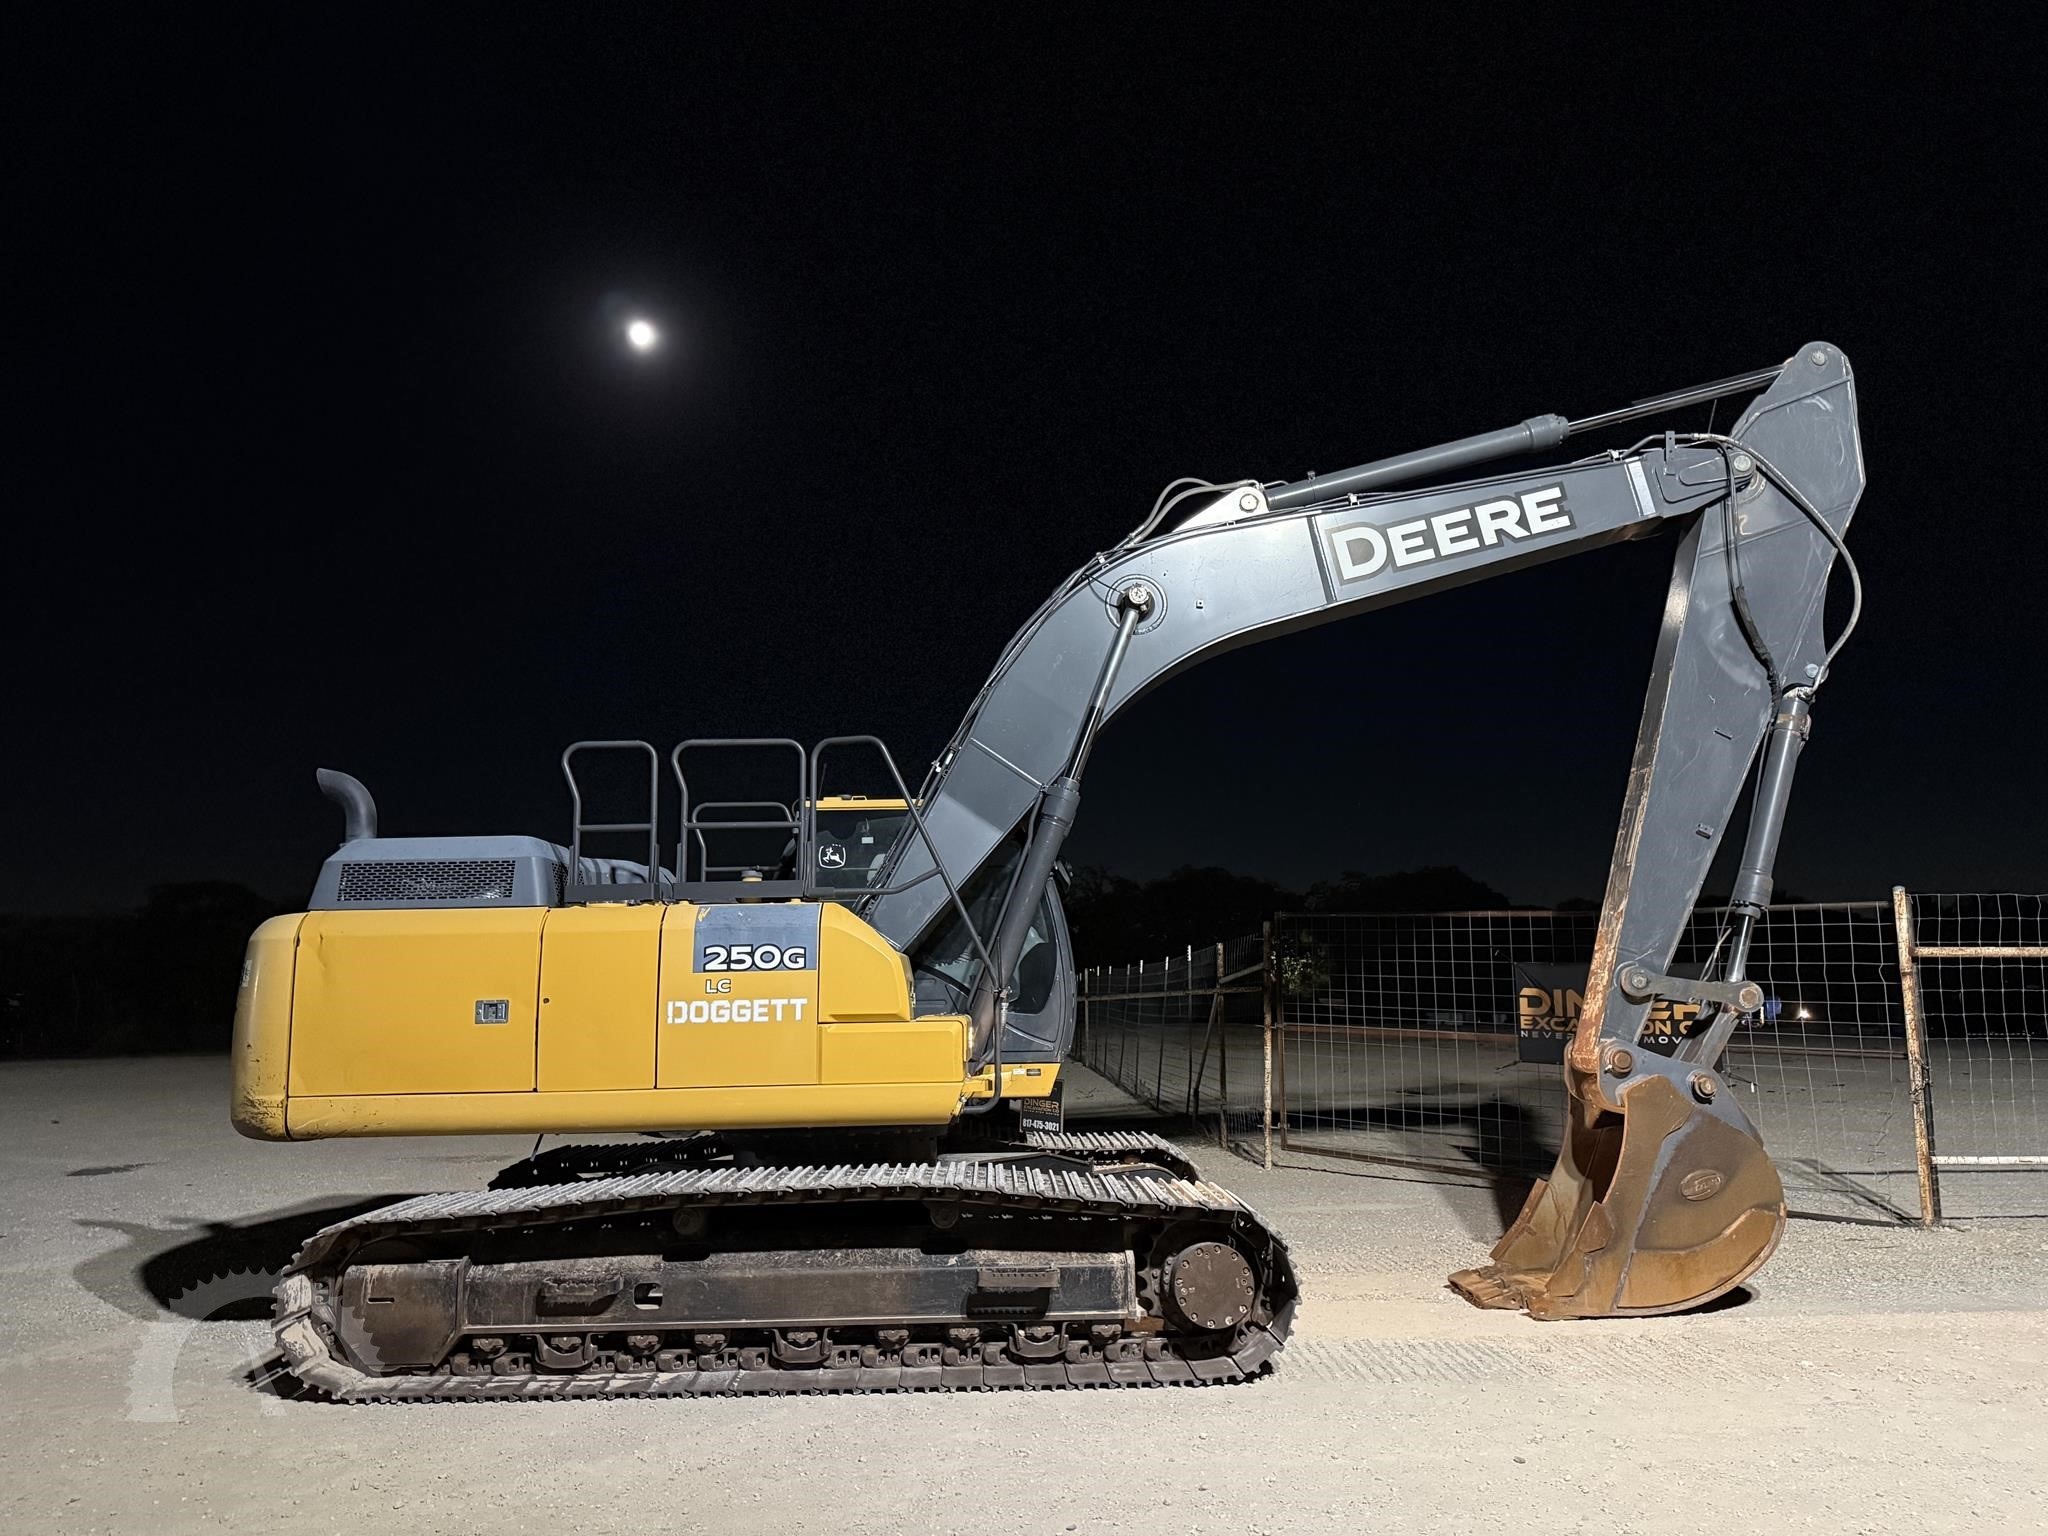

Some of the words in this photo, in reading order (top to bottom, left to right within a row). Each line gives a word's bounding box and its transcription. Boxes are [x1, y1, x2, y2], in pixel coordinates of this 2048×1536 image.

[1331, 487, 1571, 580] DEERE
[703, 943, 806, 972] 250G
[705, 978, 732, 994] LC
[667, 998, 808, 1024] DOGGETT
[1023, 1098, 1060, 1110] DINGER
